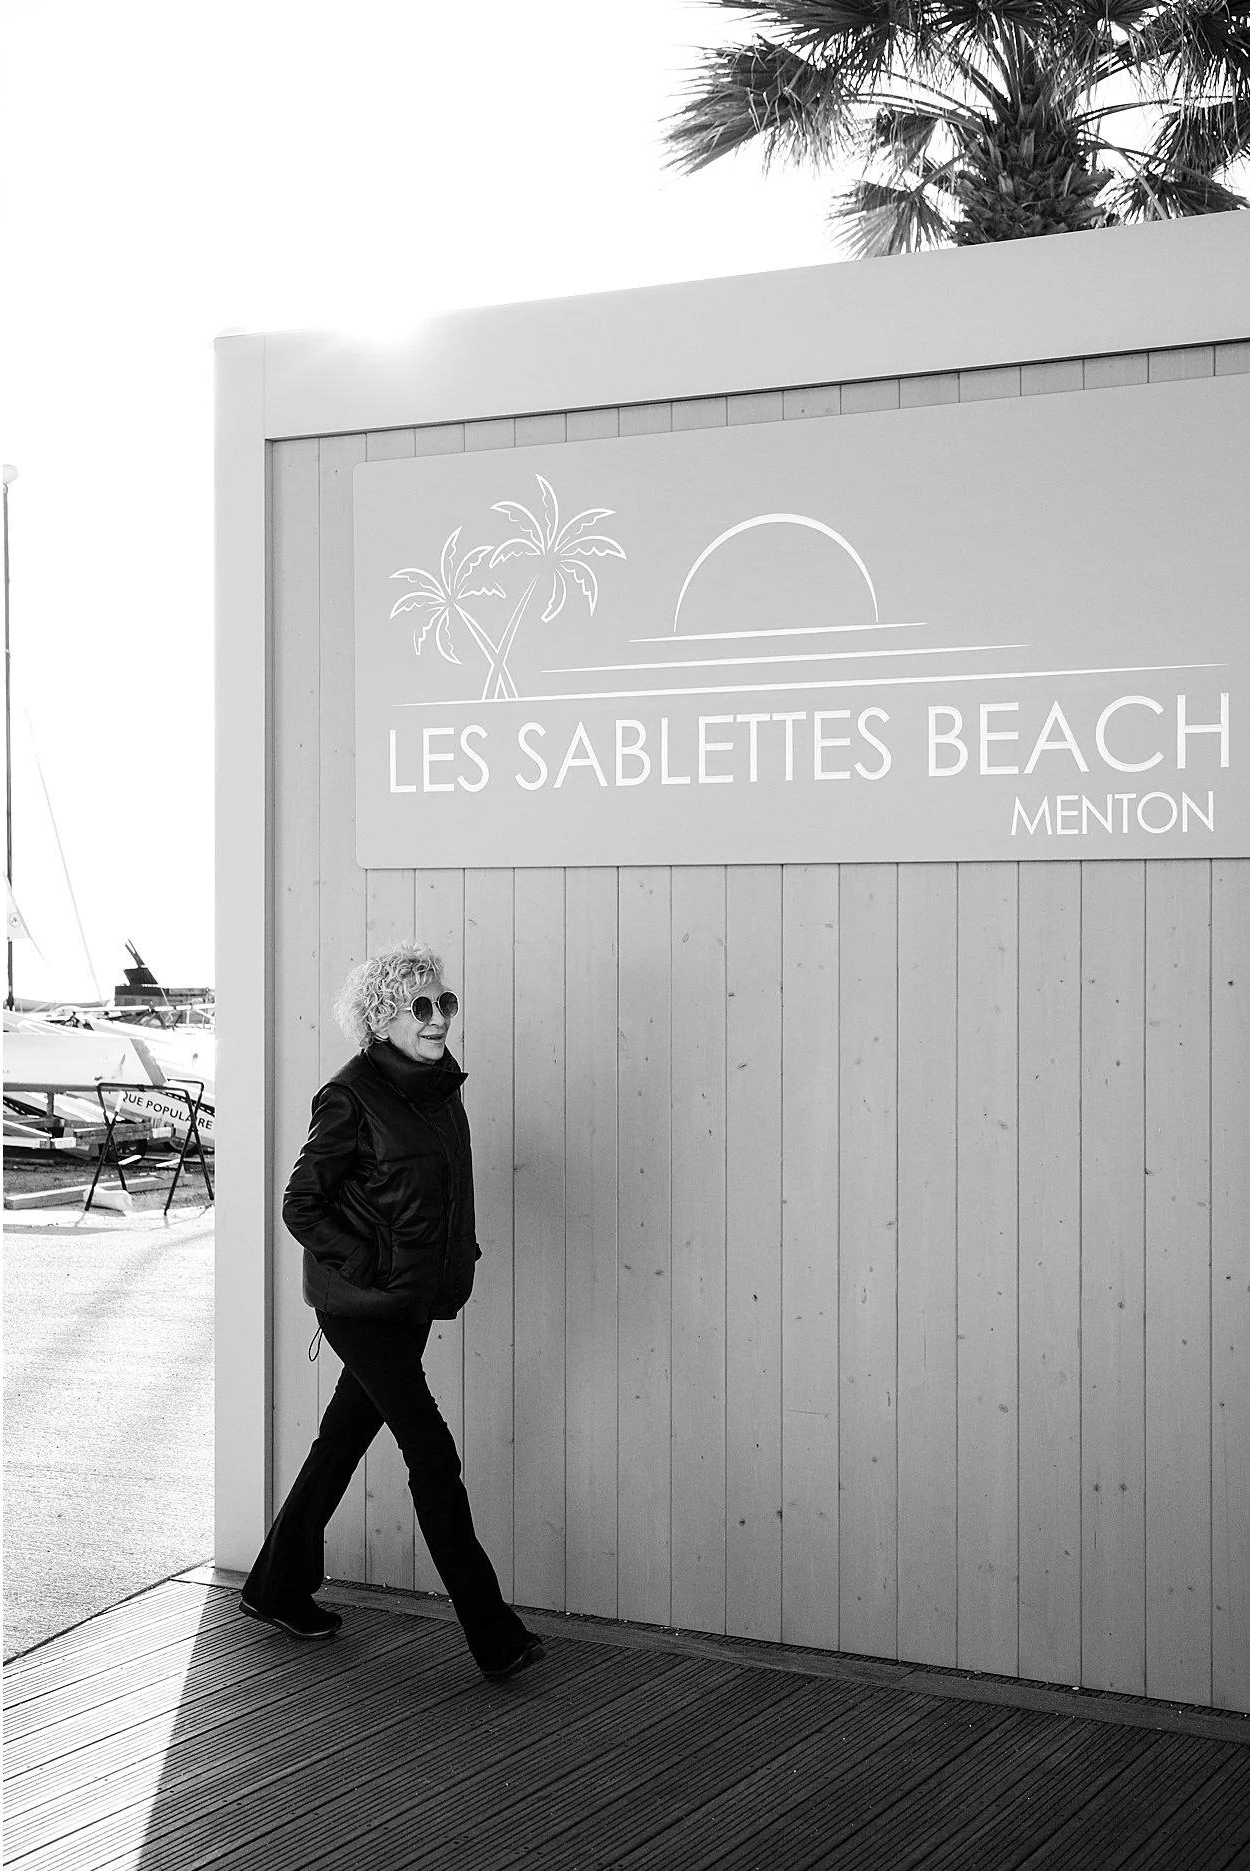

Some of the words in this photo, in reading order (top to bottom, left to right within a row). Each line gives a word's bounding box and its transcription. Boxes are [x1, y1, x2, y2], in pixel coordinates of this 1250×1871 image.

[389, 724, 490, 793] LES
[514, 706, 892, 791] SABLETTES
[928, 692, 1230, 777] BEACH
[1010, 790, 1215, 836] MENTON
[146, 1100, 213, 1130] POPULARE
